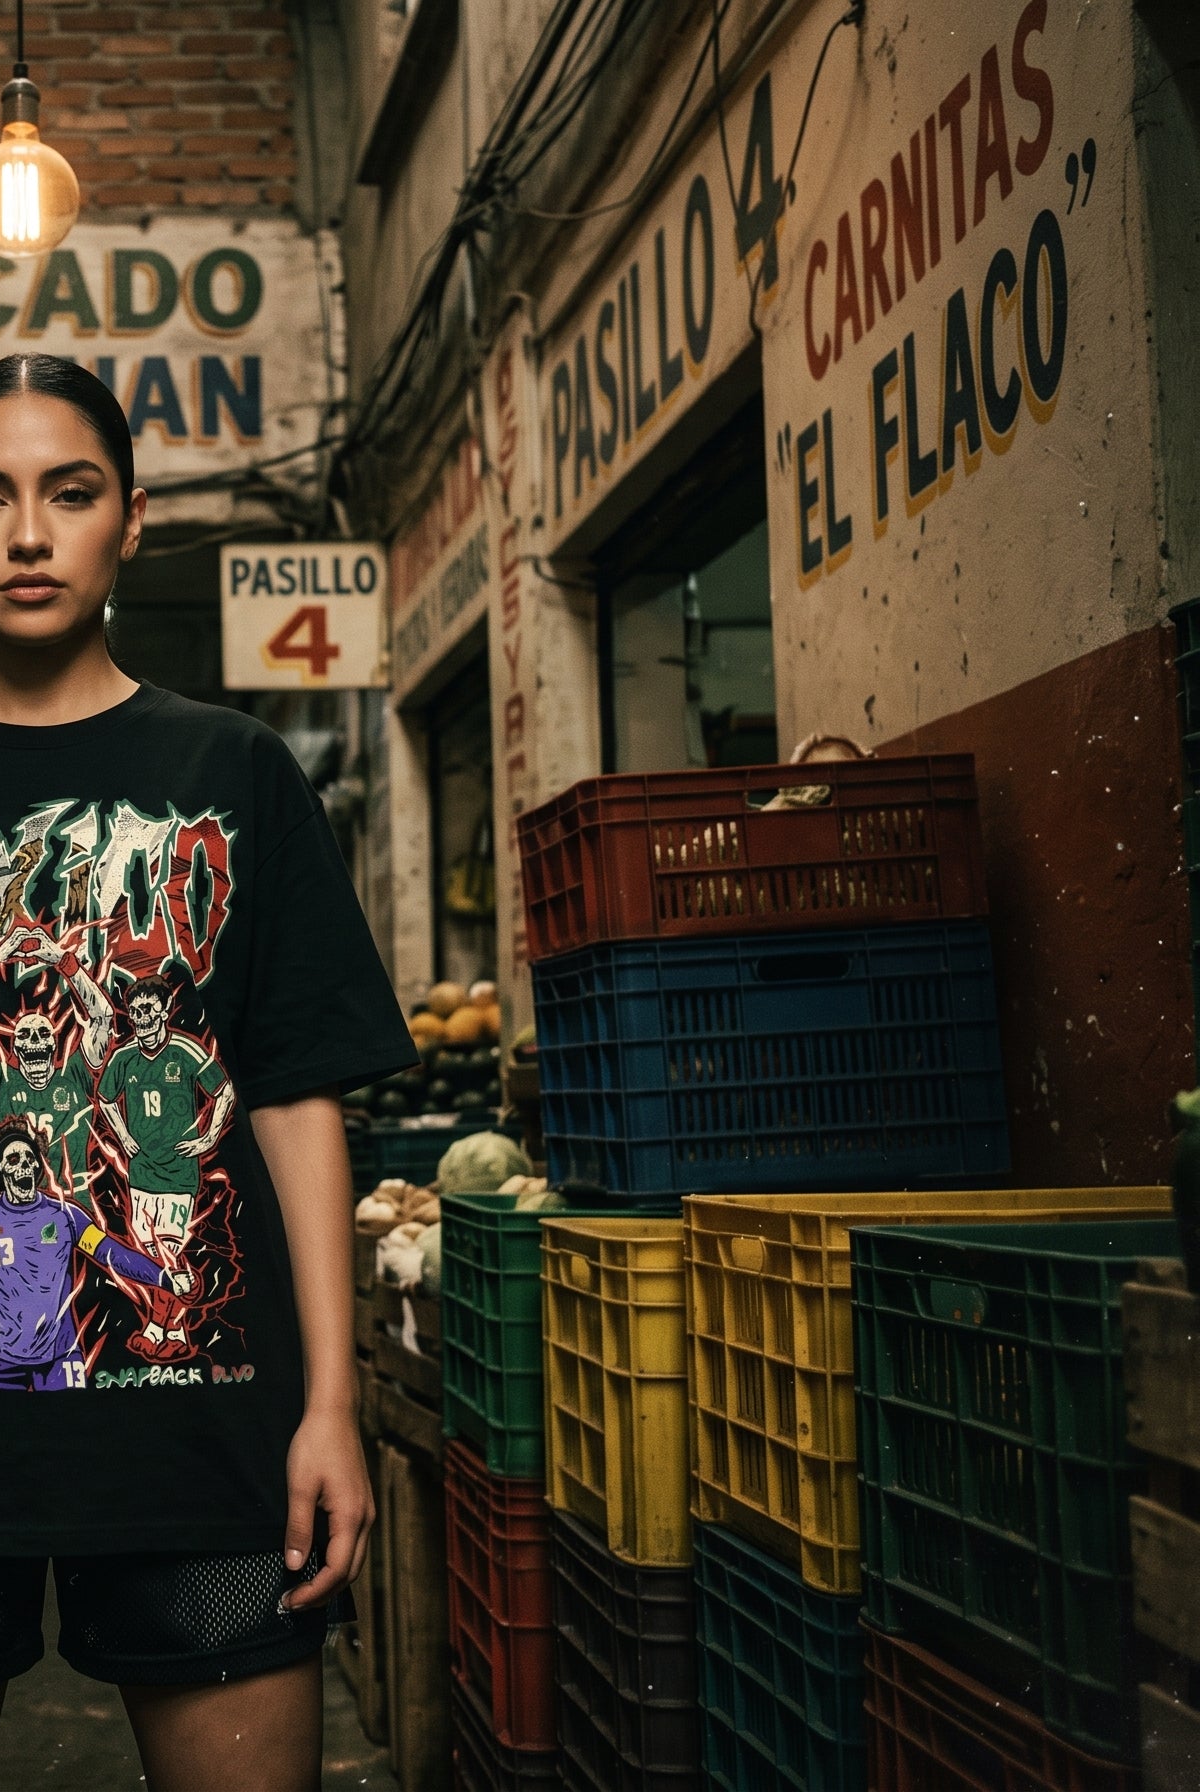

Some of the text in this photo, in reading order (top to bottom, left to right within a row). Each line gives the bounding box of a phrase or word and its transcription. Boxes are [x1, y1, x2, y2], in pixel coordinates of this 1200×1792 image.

[804, 0, 1054, 381] CARNITAS
[552, 173, 714, 520] PASILLO
[231, 556, 377, 596] PASILLO
[264, 605, 340, 681] 4
[142, 1090, 161, 1117] 19
[62, 1361, 86, 1388] 13
